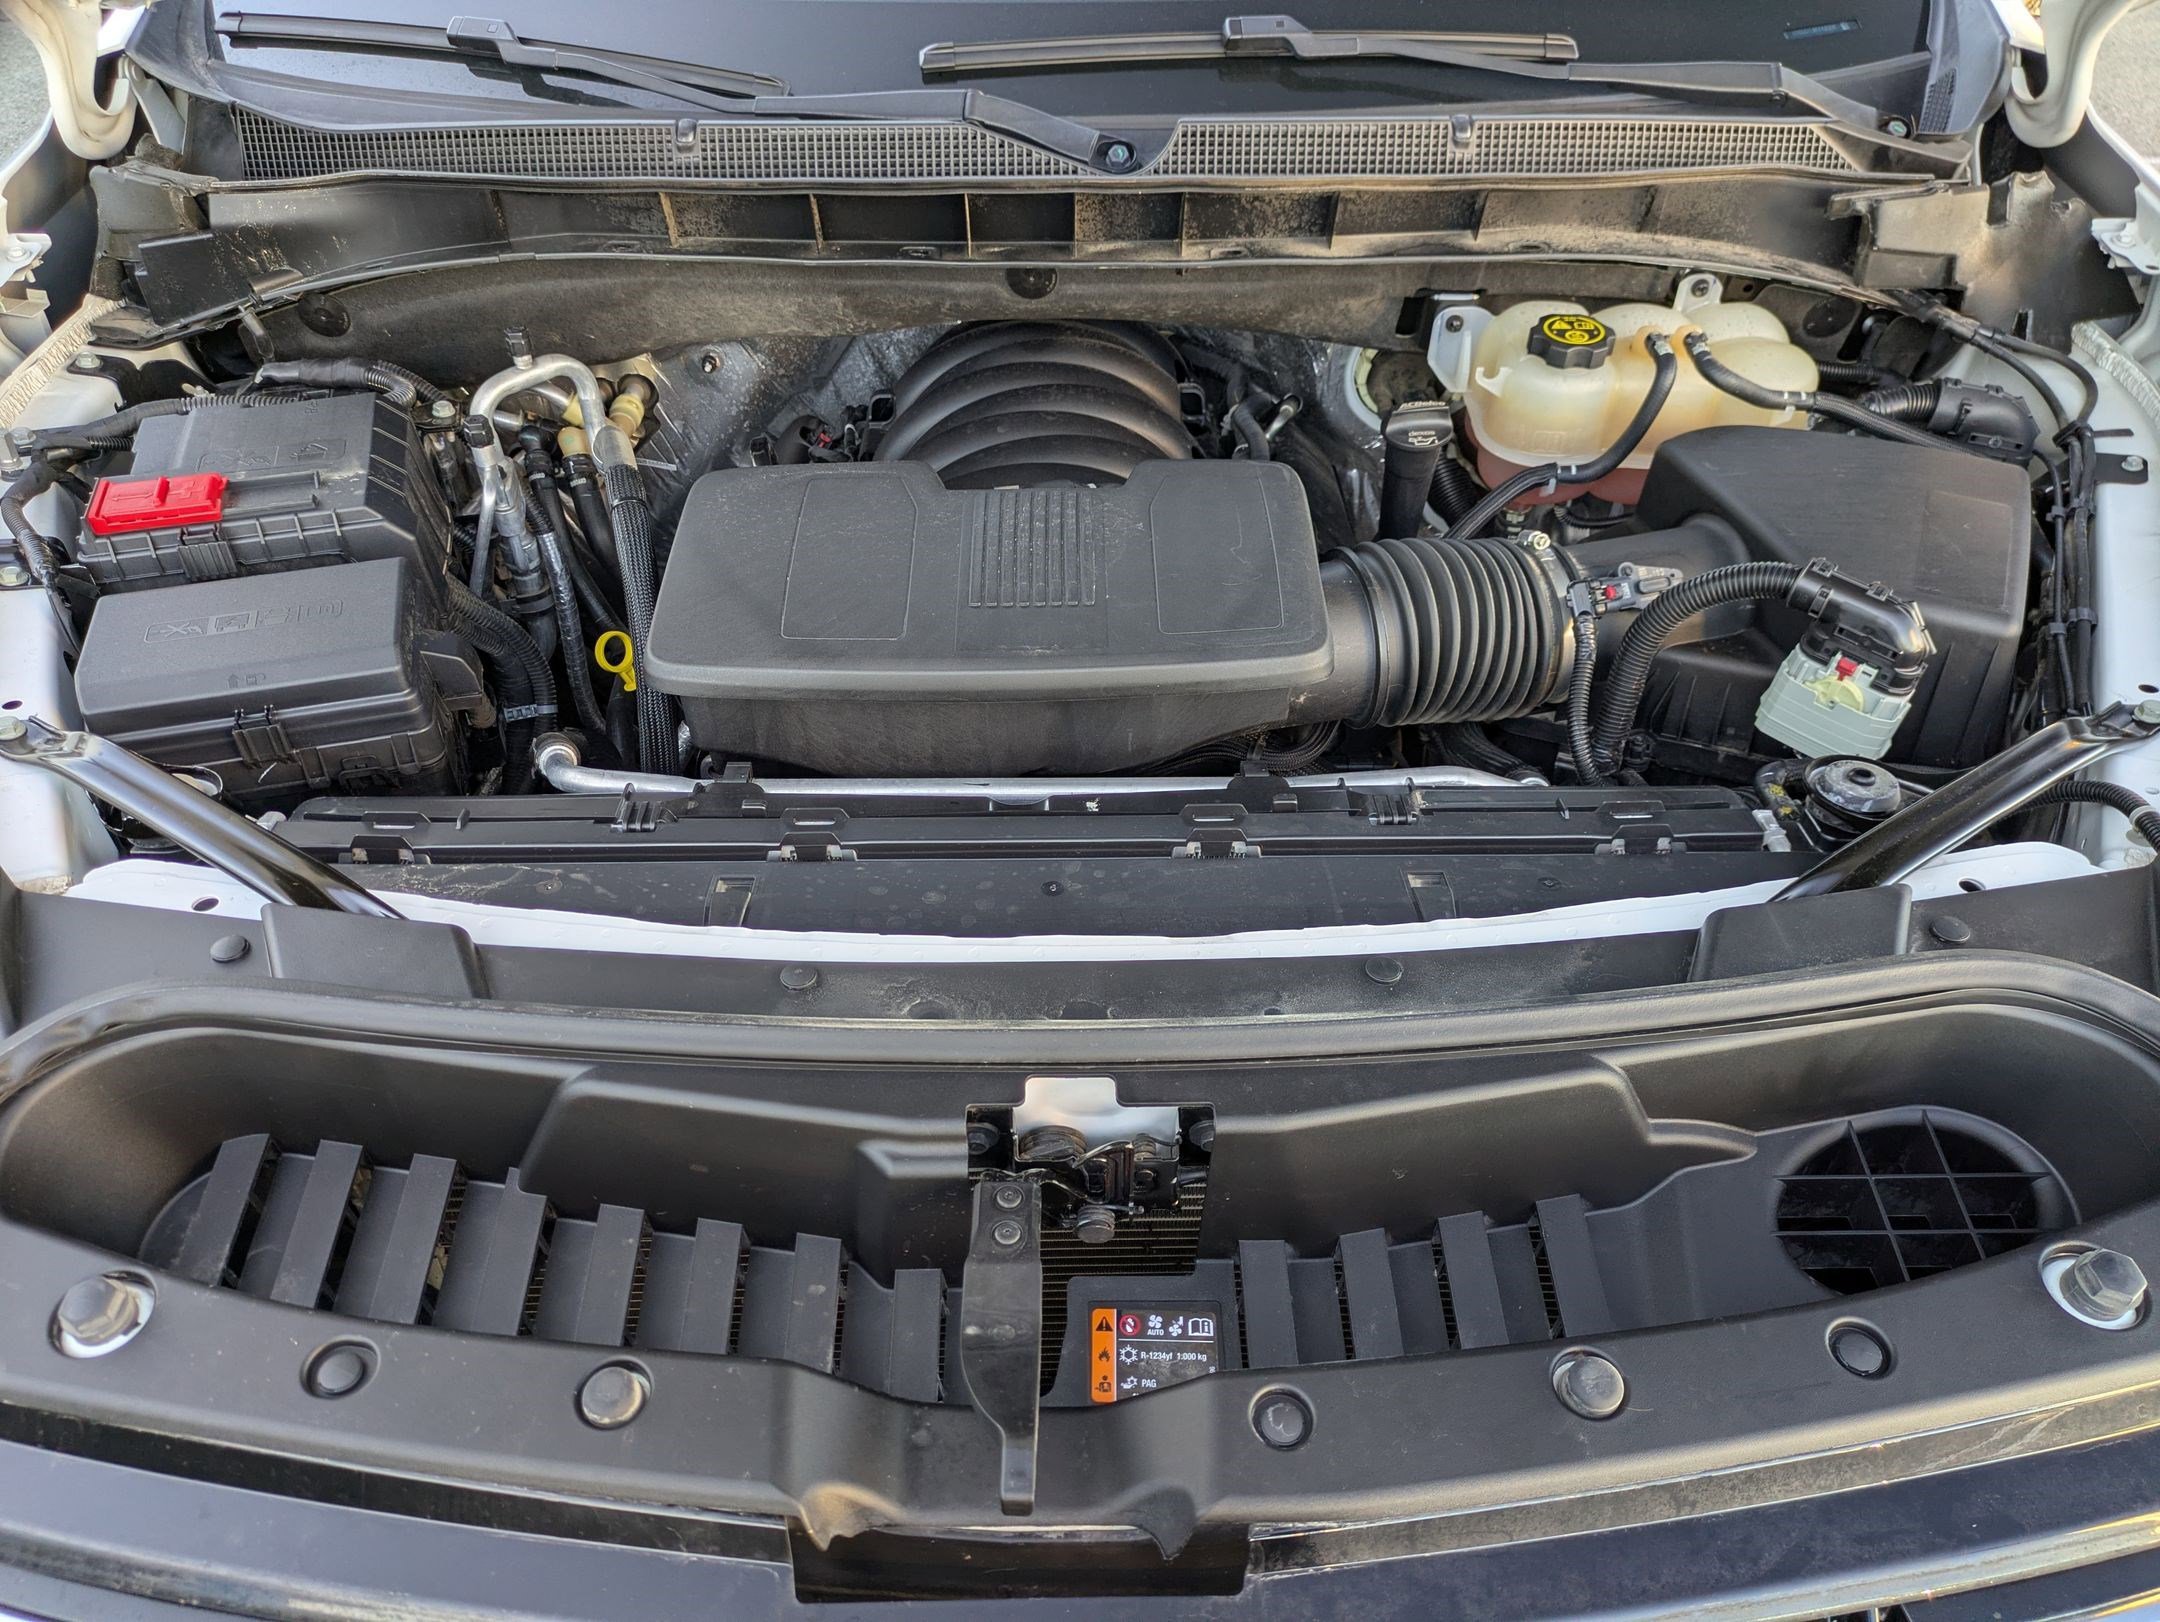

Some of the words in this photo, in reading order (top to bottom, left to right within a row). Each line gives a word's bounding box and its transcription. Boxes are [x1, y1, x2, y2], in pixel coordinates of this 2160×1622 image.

[1399, 400, 1446, 409] ACDelco
[1147, 1328, 1164, 1336] AUTO
[1140, 1351, 1173, 1362] R-1234yf
[1197, 1352, 1207, 1363] kg
[1141, 1379, 1157, 1388] PAG
